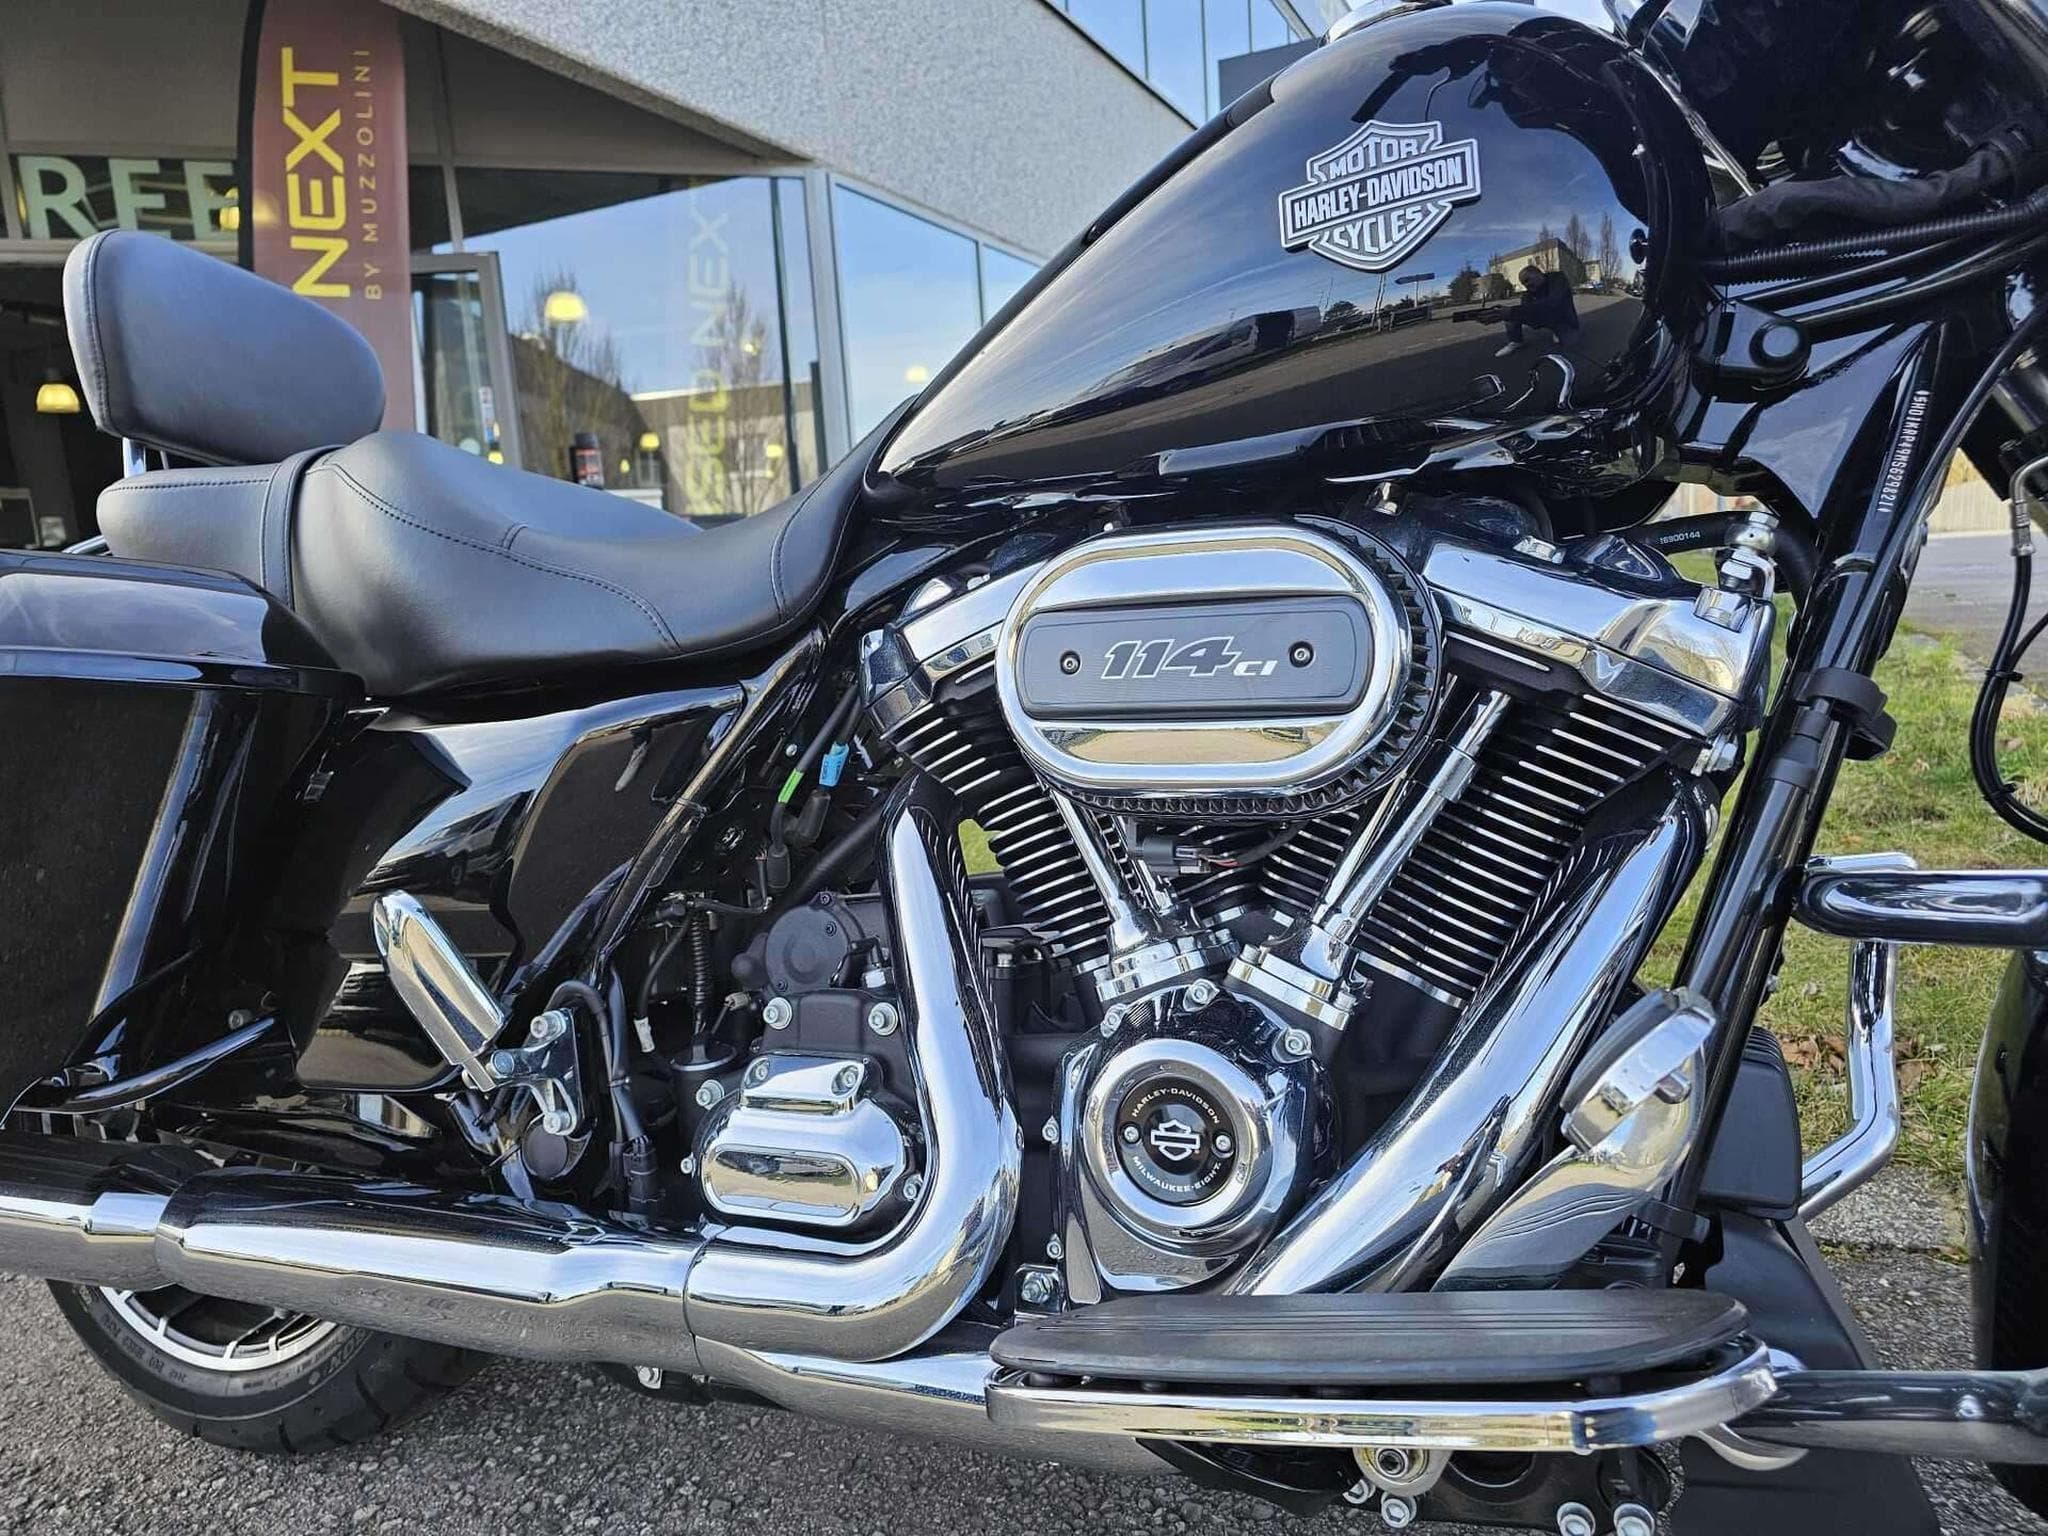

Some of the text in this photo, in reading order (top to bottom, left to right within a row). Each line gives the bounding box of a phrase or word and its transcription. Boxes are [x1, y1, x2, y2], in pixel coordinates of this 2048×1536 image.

[281, 47, 350, 298] NEXT
[353, 50, 382, 300] BY MUZZOLINI
[1293, 156, 1463, 229] HARLEY-DAVIDSON
[1329, 136, 1419, 180] MOTOR
[1333, 205, 1424, 254] CYCLES
